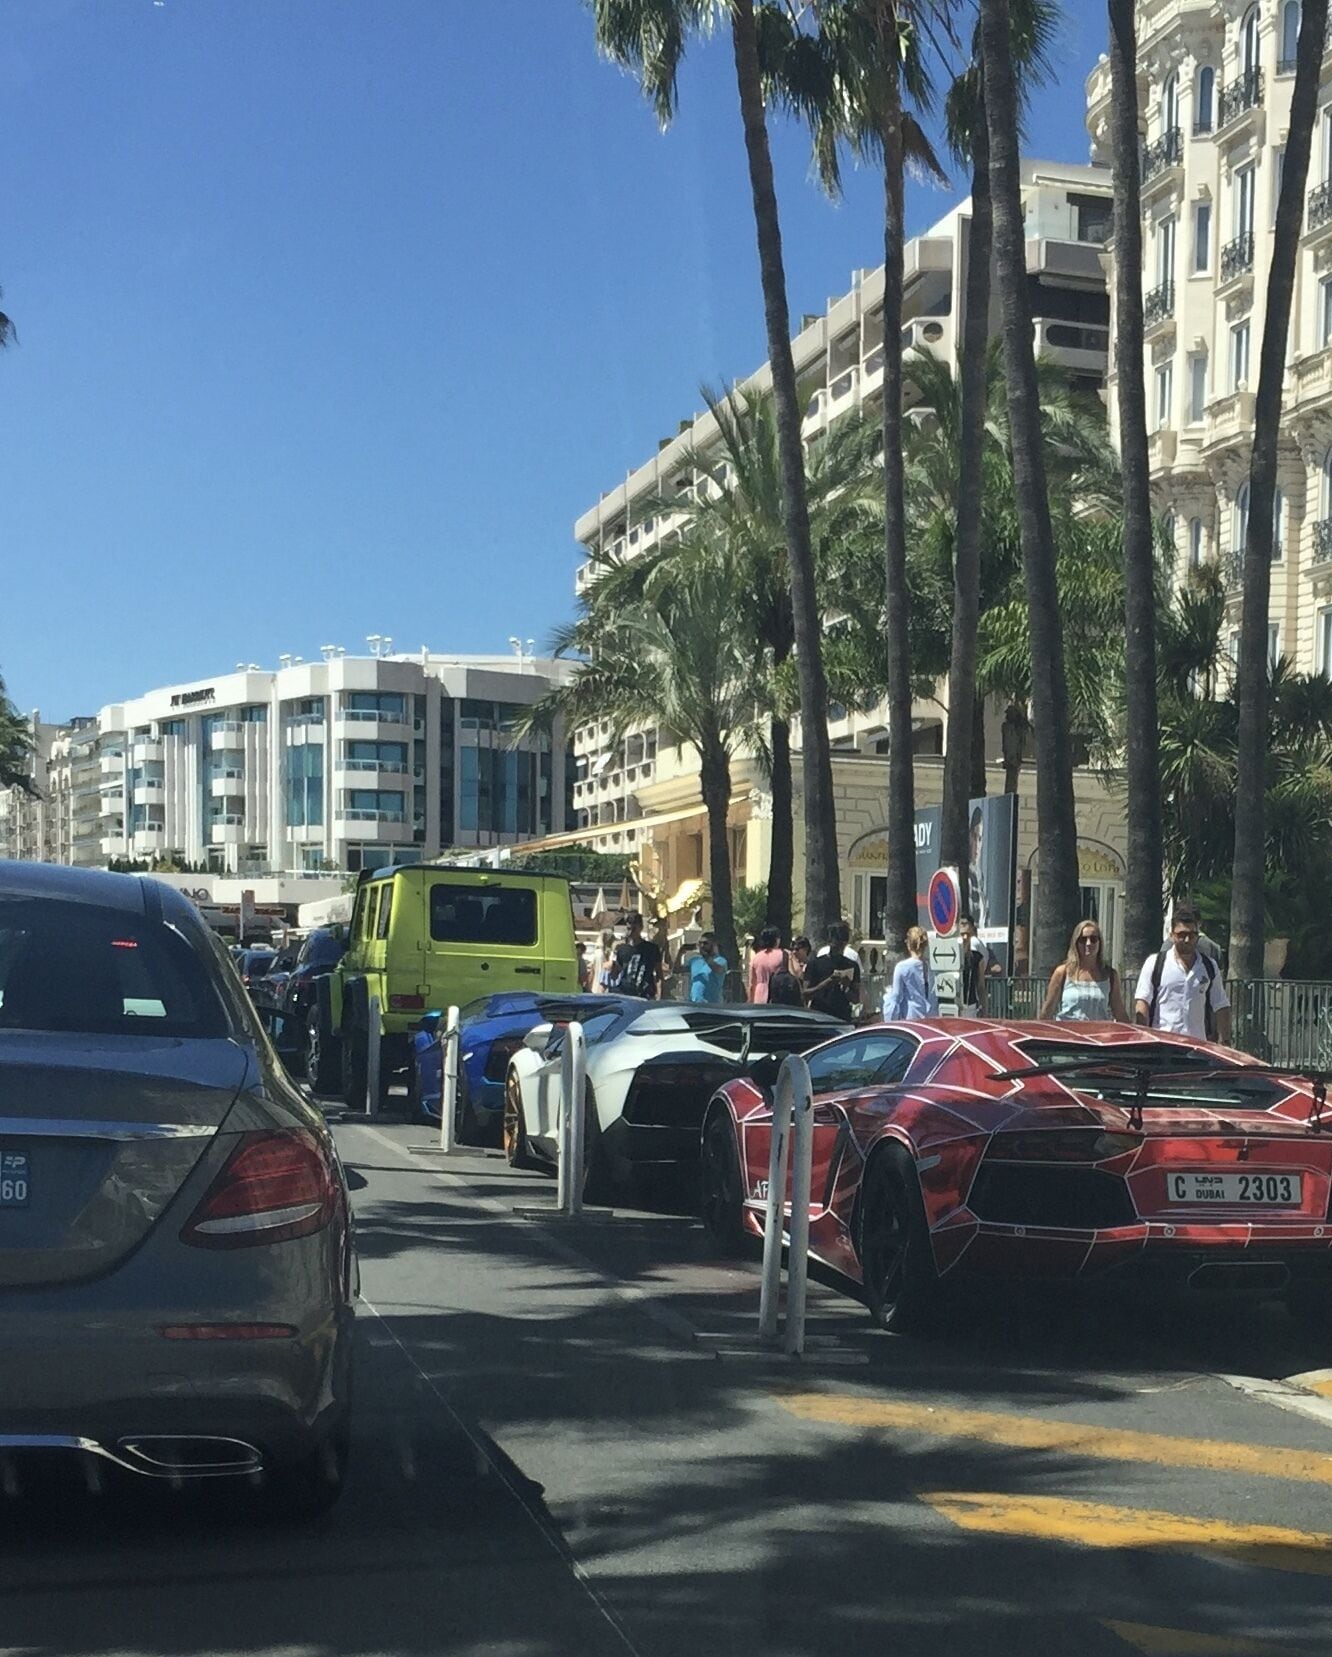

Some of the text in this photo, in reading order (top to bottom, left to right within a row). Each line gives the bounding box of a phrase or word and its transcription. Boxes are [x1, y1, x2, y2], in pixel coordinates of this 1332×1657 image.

[2, 1180, 27, 1201] 60
[1174, 1175, 1292, 1202] C 2303
[1196, 1189, 1225, 1200] DUBAI
